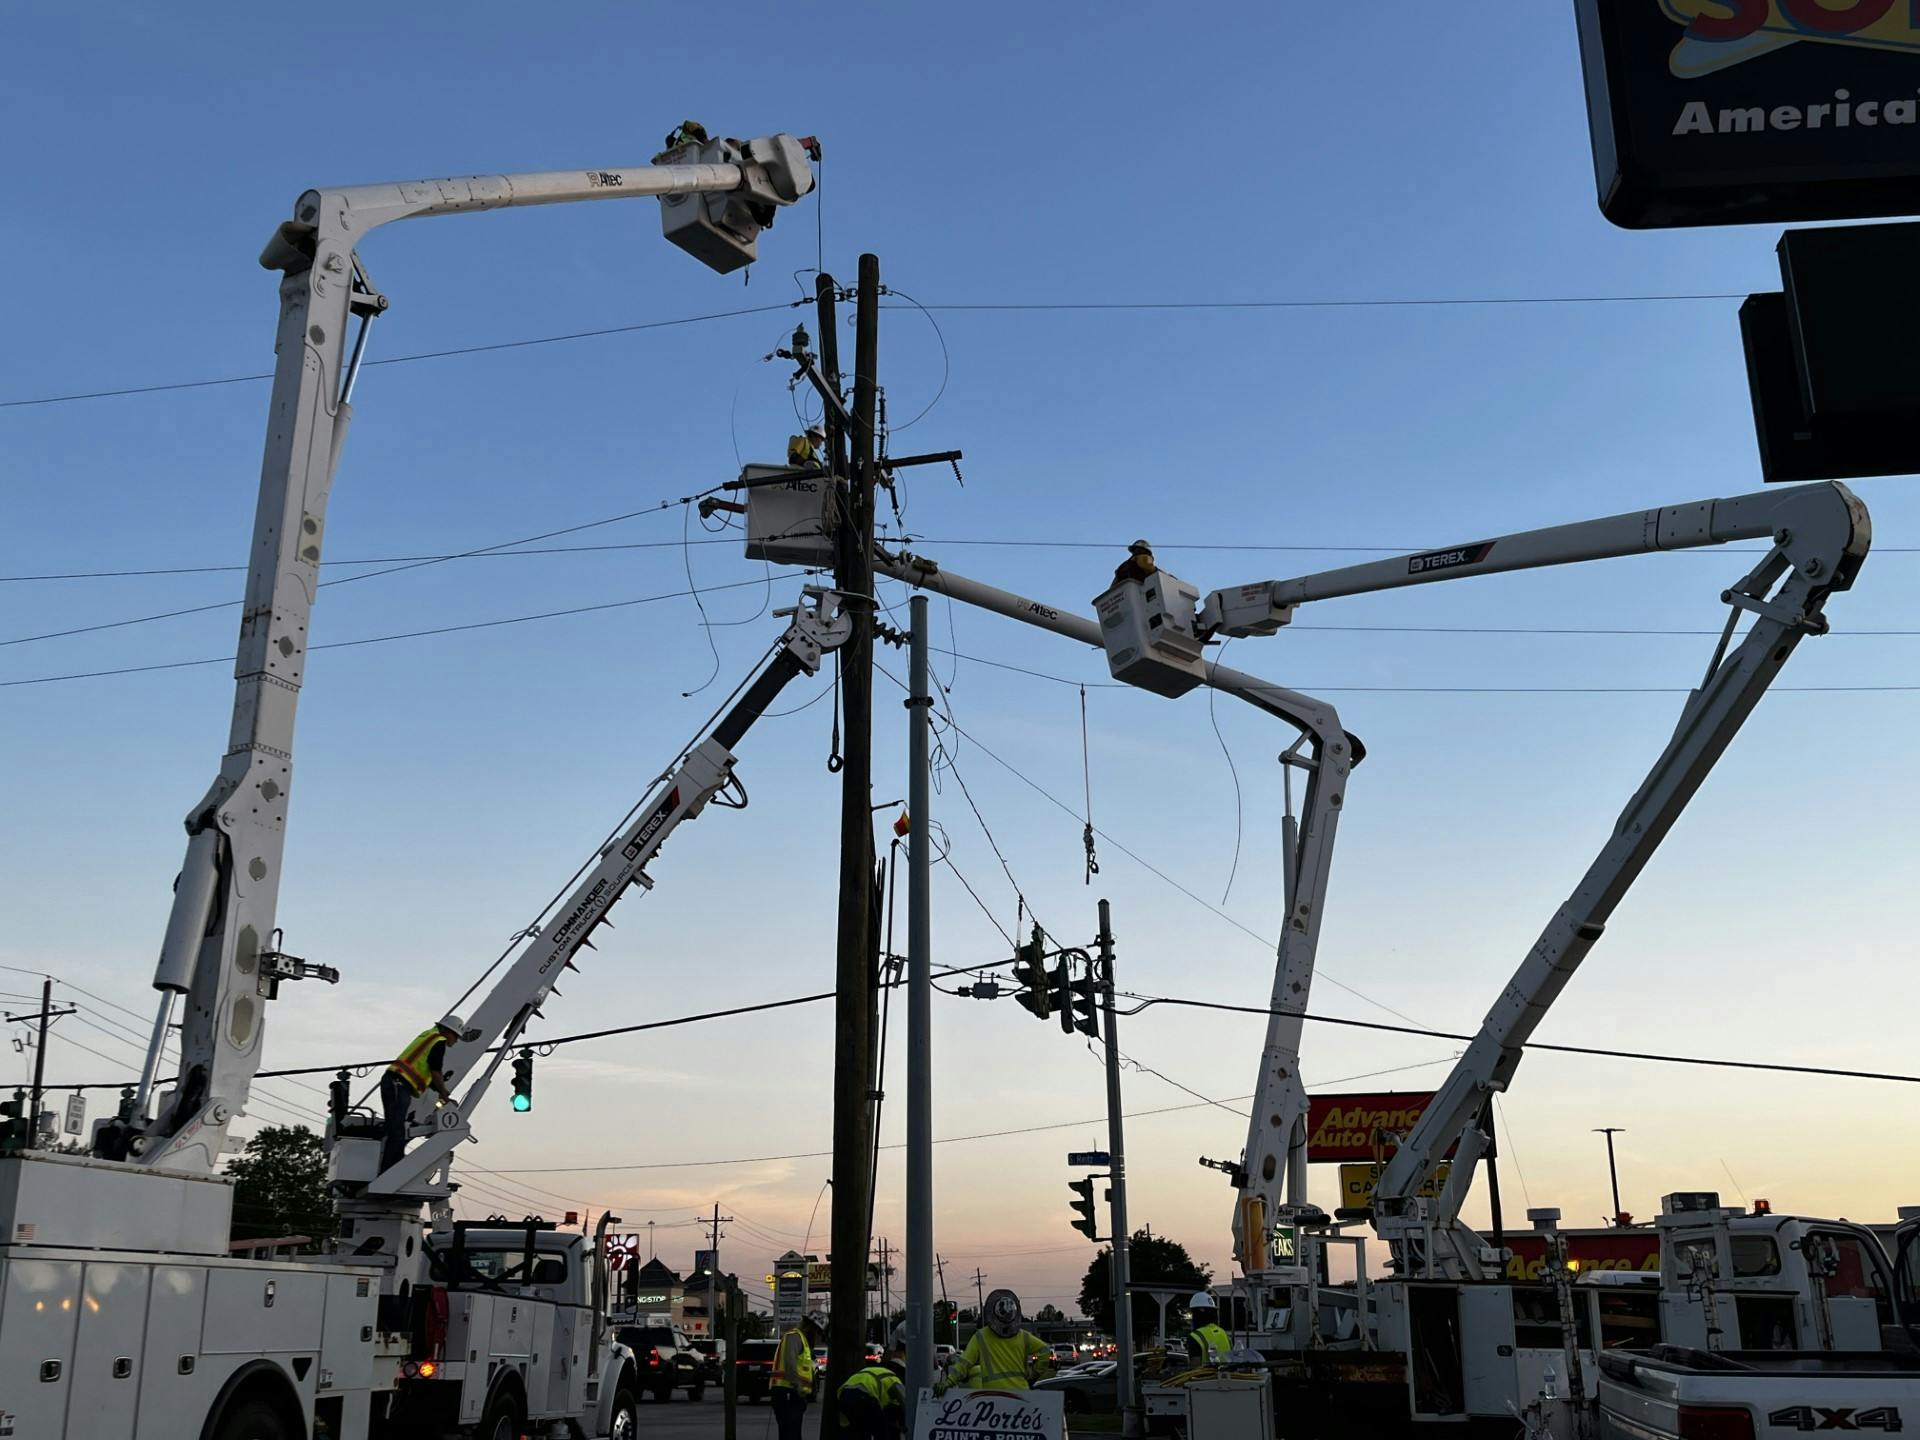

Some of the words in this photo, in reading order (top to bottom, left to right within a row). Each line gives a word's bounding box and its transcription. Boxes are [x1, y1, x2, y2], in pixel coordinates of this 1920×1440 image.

[600, 172, 622, 187] Altec
[785, 479, 817, 492] Altec
[1425, 550, 1466, 568] TEREX
[1029, 603, 1057, 620] Altec
[634, 810, 667, 845] TEREX
[538, 937, 572, 975] CUSTOM
[571, 905, 598, 936] TRUCK
[604, 862, 634, 897] SOURCE
[552, 878, 608, 944] COMMANDER
[1323, 1106, 1422, 1130] Advanc
[1309, 1128, 1367, 1148] Auto
[1768, 1406, 1903, 1432] 4X4
